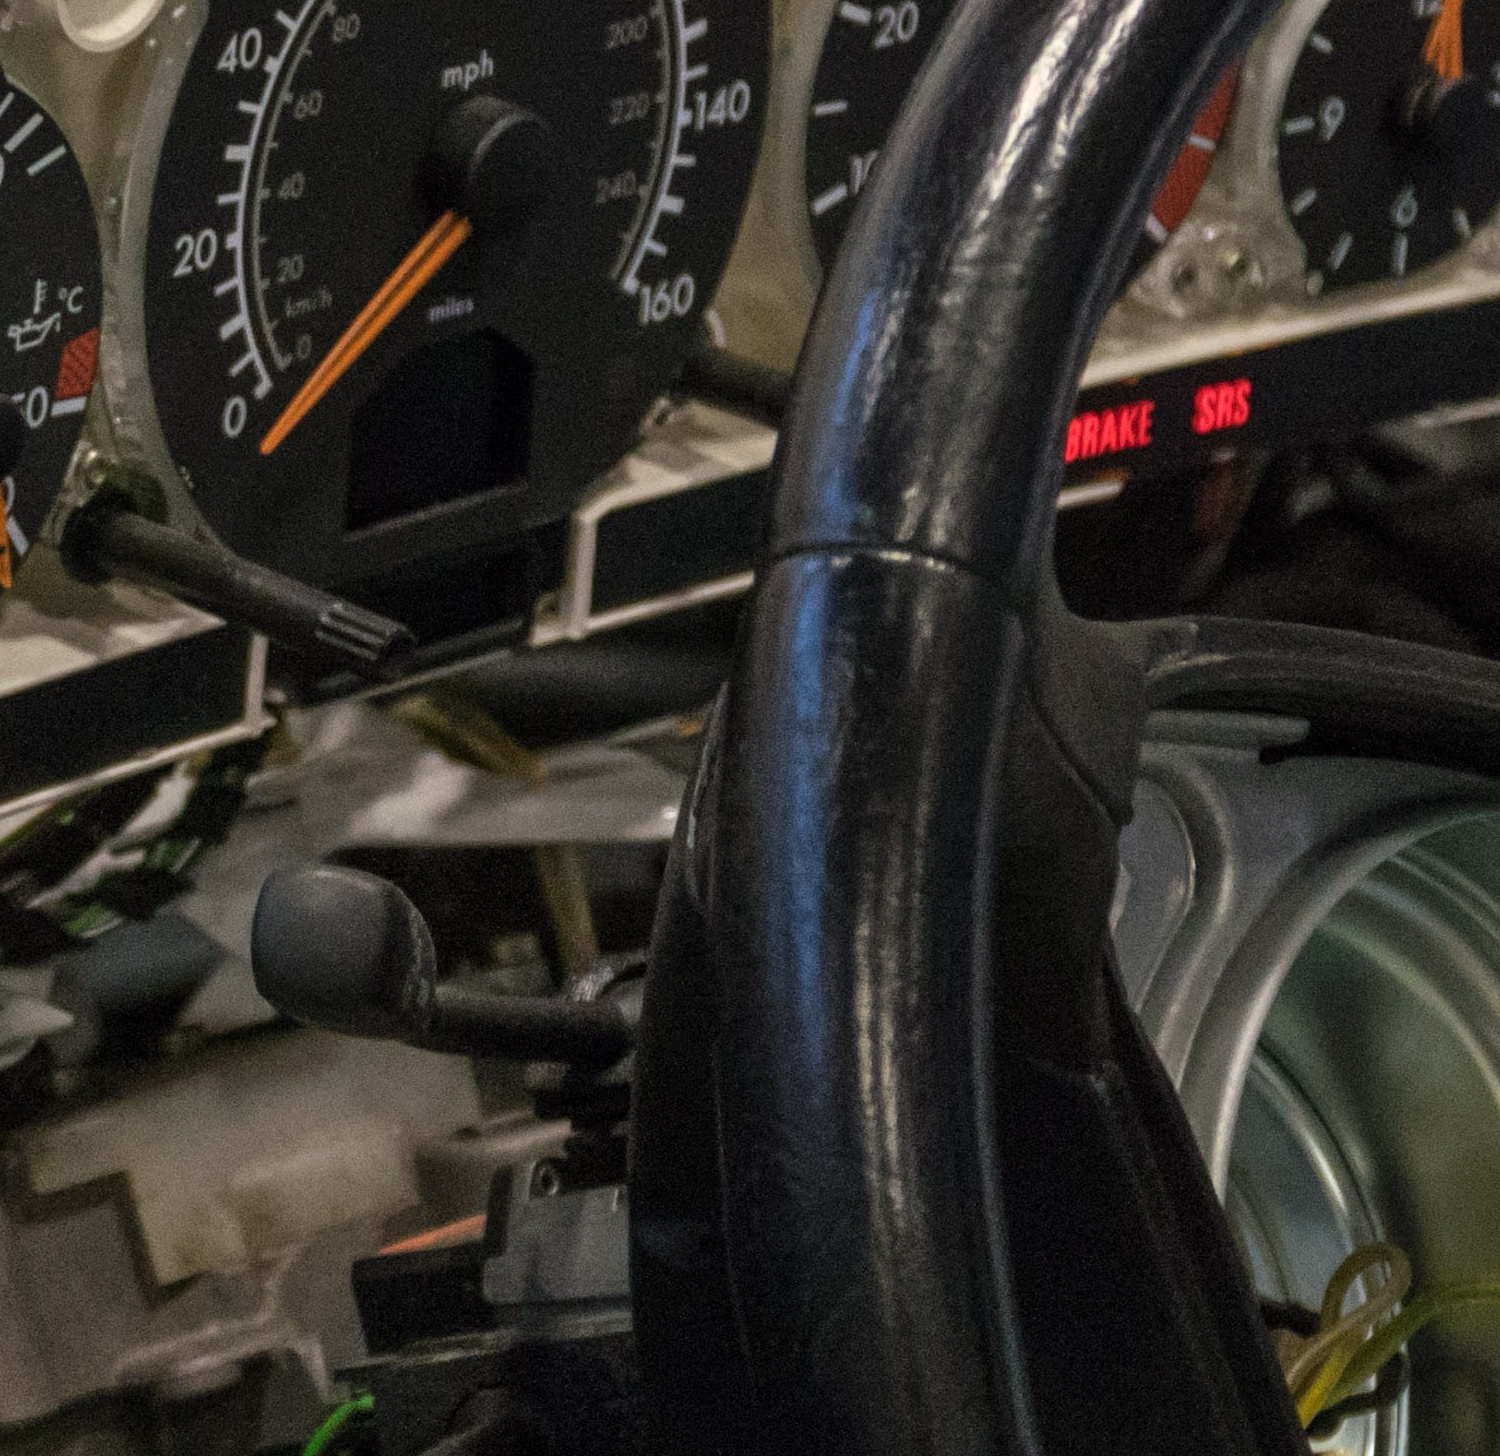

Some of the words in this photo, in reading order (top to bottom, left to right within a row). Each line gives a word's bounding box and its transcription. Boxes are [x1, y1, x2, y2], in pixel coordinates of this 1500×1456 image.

[333, 15, 361, 43] 80
[607, 16, 648, 47] 200
[874, 2, 920, 48] 20
[217, 27, 263, 74] 40
[441, 50, 495, 90] mph
[294, 91, 322, 120] 60
[610, 94, 650, 125] 220
[695, 80, 750, 131] 140
[1318, 100, 1345, 142] 9
[278, 172, 306, 202] 40
[1393, 188, 1417, 227] 6
[174, 229, 218, 279] 20
[276, 252, 304, 283] 20
[428, 297, 474, 322] miles
[640, 274, 694, 325] 160
[297, 333, 312, 360] 0
[222, 396, 248, 439] 0
[1064, 399, 1155, 463] BRAKE
[1192, 377, 1253, 435] SRS
